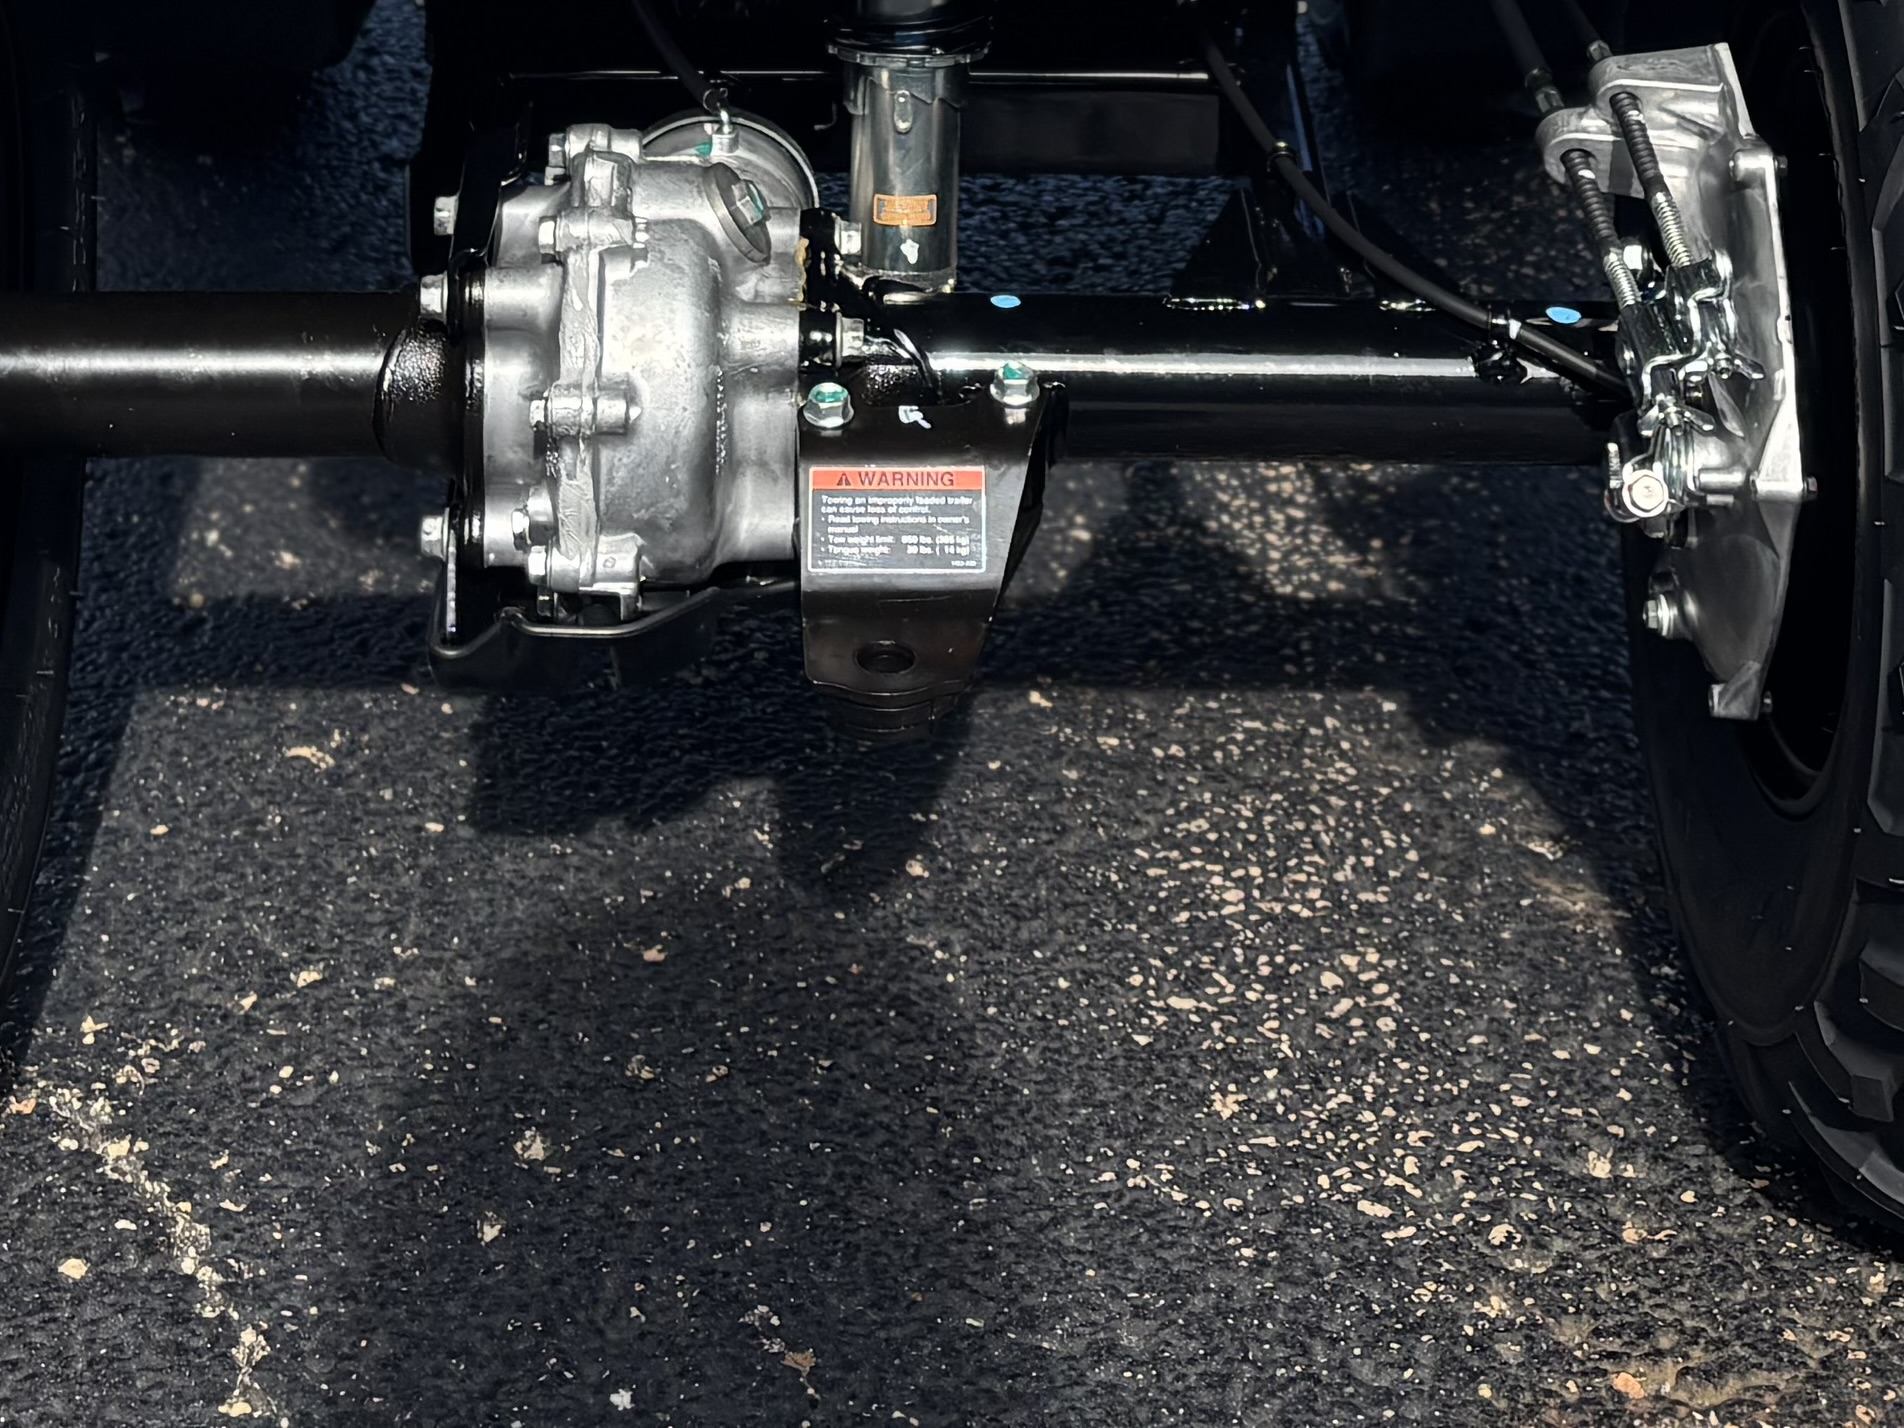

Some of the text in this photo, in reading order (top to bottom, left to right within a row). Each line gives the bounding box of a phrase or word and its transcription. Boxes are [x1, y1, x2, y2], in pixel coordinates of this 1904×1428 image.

[858, 471, 955, 487] WARNING
[821, 495, 853, 505] Towing
[868, 496, 914, 506] improperly
[947, 496, 973, 504] trailer
[867, 505, 886, 513] loss
[887, 505, 897, 513] of
[827, 516, 851, 524] Read
[828, 535, 846, 544] Tow
